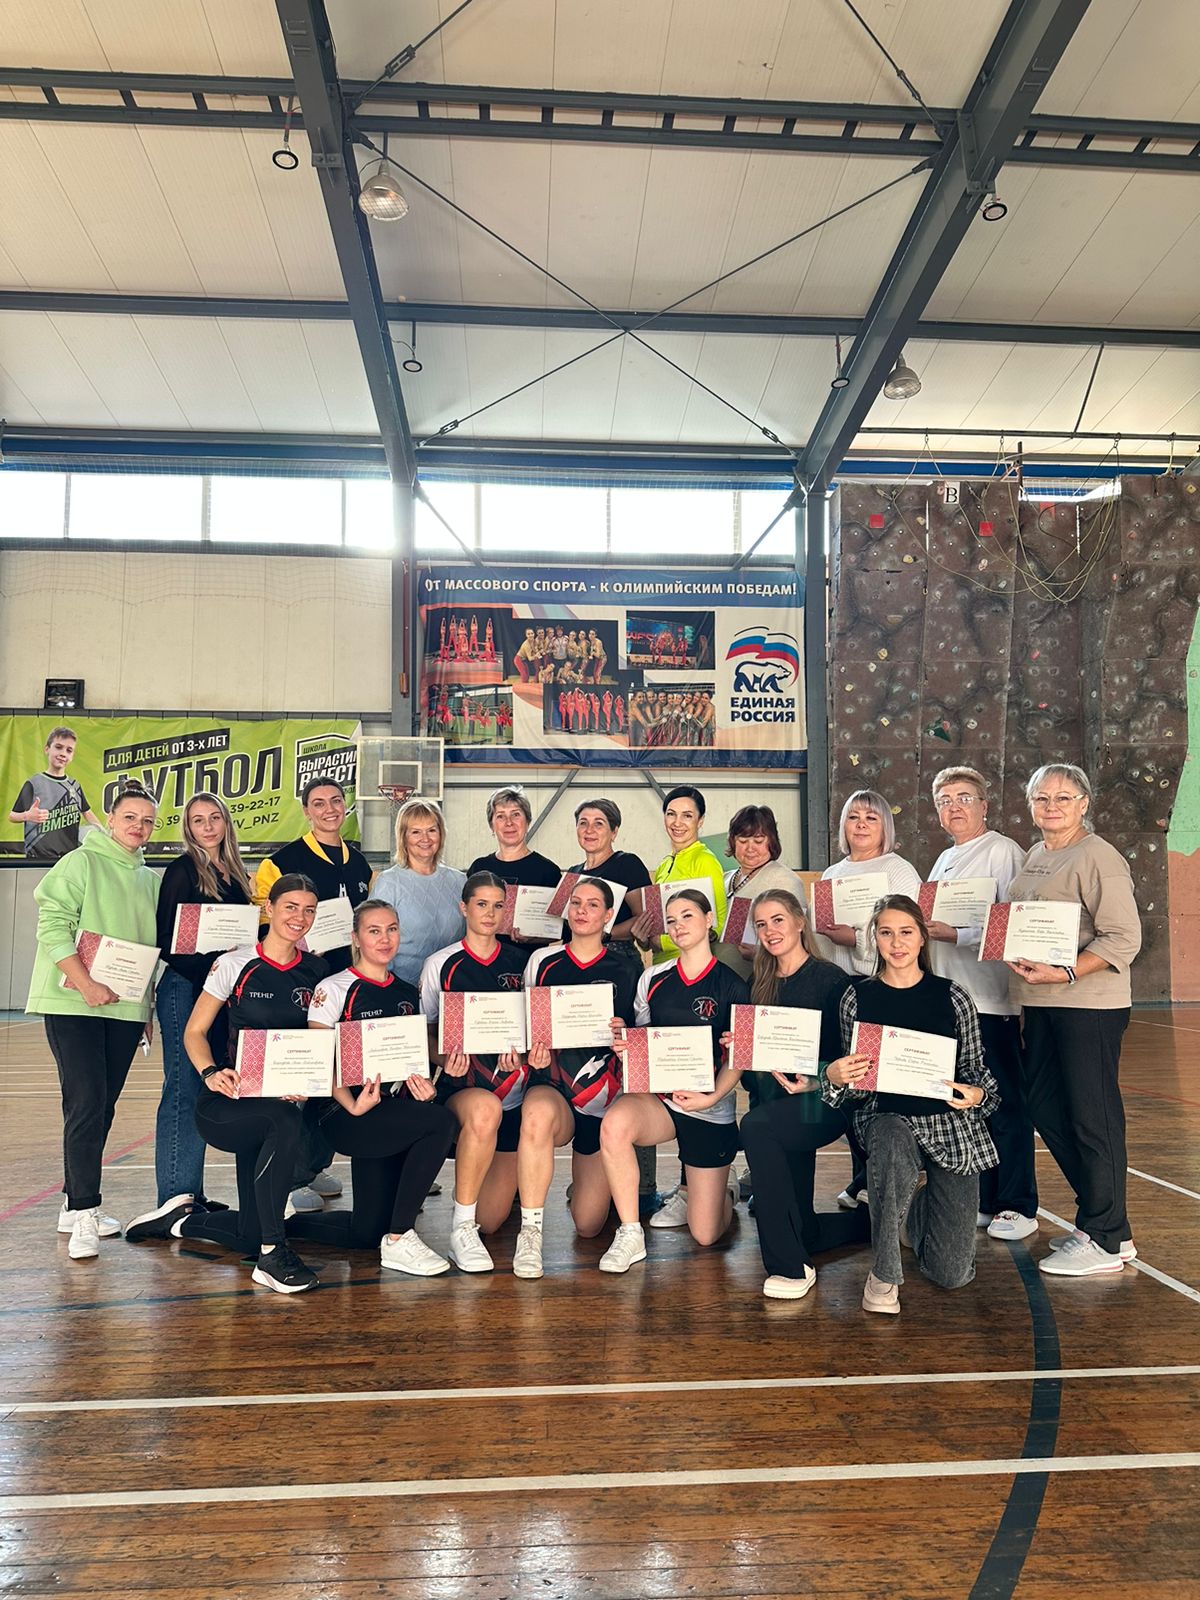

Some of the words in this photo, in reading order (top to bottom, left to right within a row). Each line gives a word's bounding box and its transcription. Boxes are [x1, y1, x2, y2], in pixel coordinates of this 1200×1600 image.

[424, 578, 441, 592] ОТ
[444, 579, 529, 591] МАССОВОГО
[533, 580, 587, 592] СПОРТА
[600, 582, 609, 593] К
[612, 580, 723, 594] ОЛИМПИЙСКИМ
[727, 582, 797, 597] ПОБЕДАМ!
[730, 697, 795, 709] ЕДИНАЯ
[730, 710, 796, 722] РОССИЯ
[106, 751, 133, 768] ДЛЯ
[134, 742, 169, 763] ДЕТЕЙ
[172, 741, 185, 755] ОТ
[206, 735, 228, 748] ЛЕТ
[303, 743, 327, 754] ШКОЛА
[230, 796, 281, 814] 39-22-17
[42, 812, 80, 833] ВМЕСТЕ
[233, 812, 280, 830] V_PNZ
